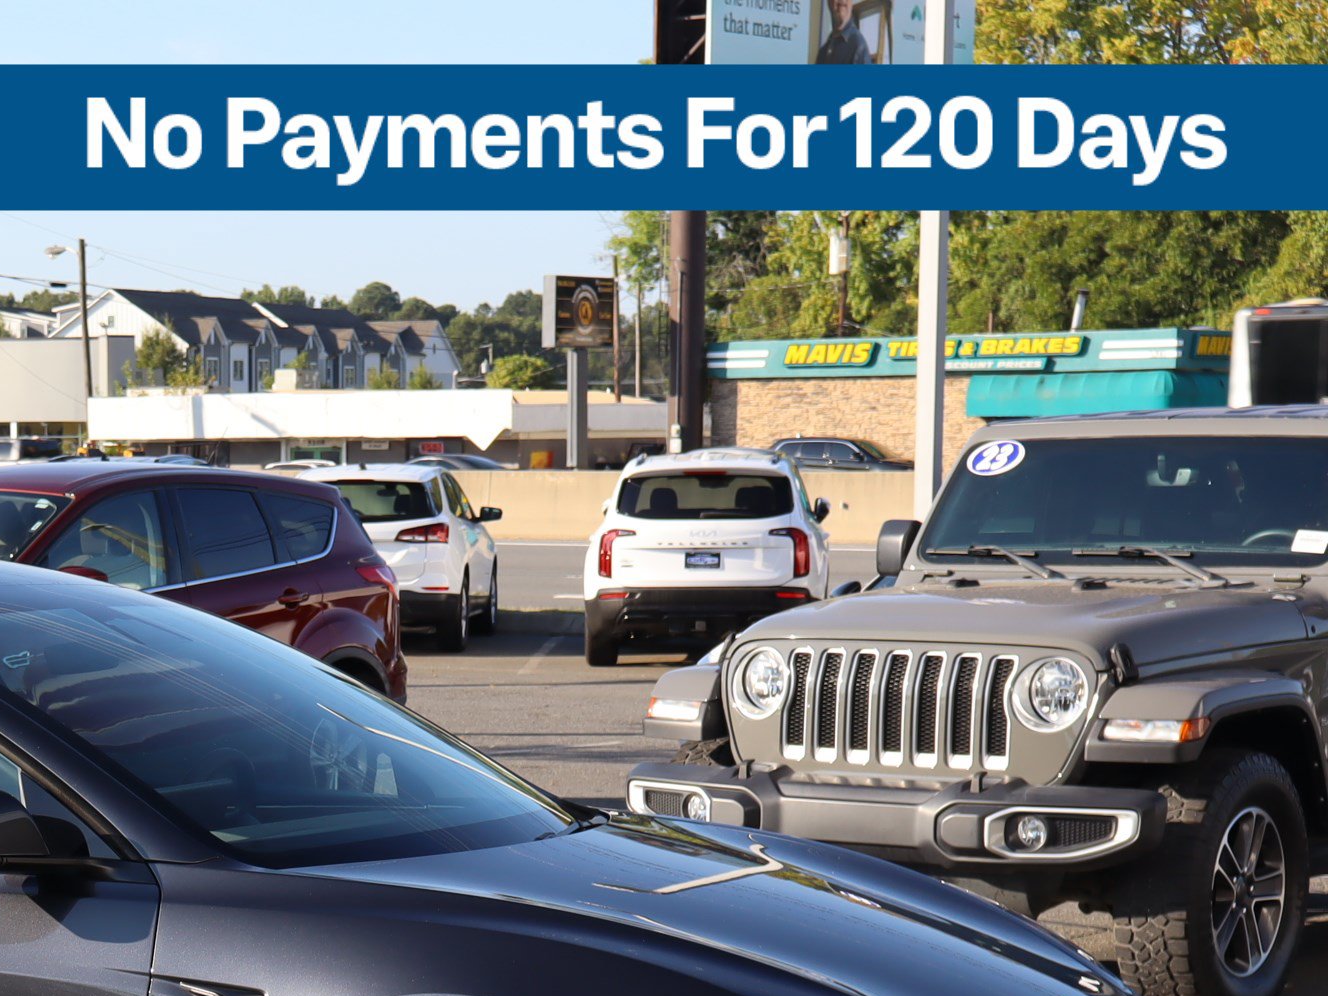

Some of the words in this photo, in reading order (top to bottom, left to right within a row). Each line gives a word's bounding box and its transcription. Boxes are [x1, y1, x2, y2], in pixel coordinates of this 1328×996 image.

[723, 12, 749, 35] that
[753, 22, 793, 41] matter
[783, 342, 873, 365] MAVIS
[887, 341, 956, 357] TIRS
[959, 341, 975, 356] &
[979, 336, 1082, 356] BRAKES
[996, 360, 1043, 369] PRICES
[975, 443, 1015, 471] 23
